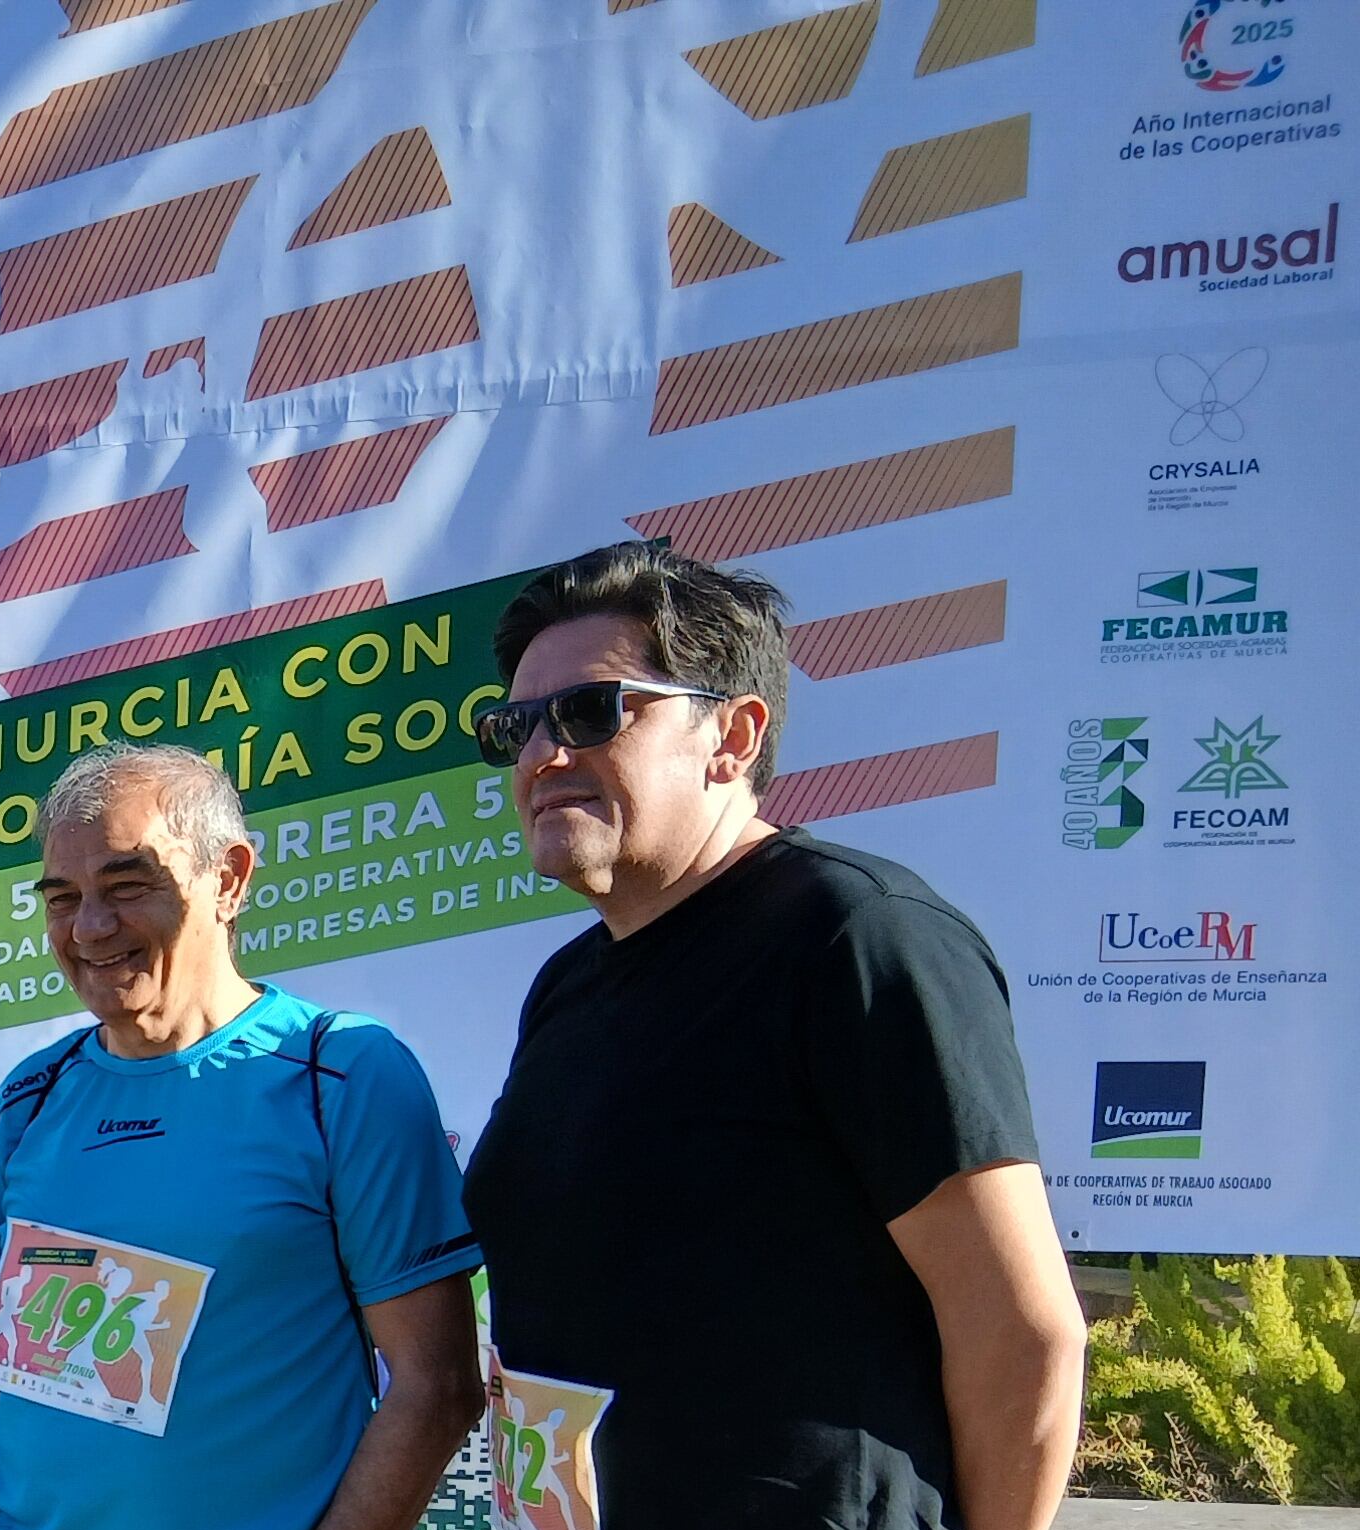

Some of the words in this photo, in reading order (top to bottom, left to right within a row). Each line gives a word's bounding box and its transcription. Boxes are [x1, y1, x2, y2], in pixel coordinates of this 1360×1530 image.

[1231, 19, 1295, 45] 2025
[1133, 116, 1176, 135] Año
[1183, 94, 1332, 130] Internacional
[1120, 142, 1145, 160] de
[1152, 140, 1183, 158] las
[1191, 121, 1342, 154] Cooperativas
[1117, 202, 1340, 284] amusal
[1199, 272, 1269, 293] Sociedad
[1273, 268, 1334, 285] Laboral
[1148, 457, 1261, 481] CRYSALIA
[1102, 610, 1288, 642] FECAMUR
[282, 613, 452, 699] CON
[1059, 718, 1103, 806] AÑOS
[1173, 807, 1290, 830] FECOAM
[240, 896, 416, 955] MPRESAS
[431, 883, 480, 916] DE
[1027, 972, 1073, 987] Unión
[1077, 974, 1098, 986] de
[1102, 971, 1206, 988] Cooperativas
[1211, 971, 1231, 984] de
[1237, 969, 1327, 984] Enseñanza
[1083, 990, 1104, 1004] de
[1108, 990, 1122, 1003] la
[1127, 988, 1183, 1006] Región
[1188, 989, 1208, 1002] de
[1212, 988, 1267, 1002] Murcia
[97, 1117, 162, 1135] Ucomur
[1104, 1105, 1192, 1126] Ucomur
[1056, 1175, 1070, 1188] DE
[1074, 1175, 1147, 1189] COOPERATIVAS
[1151, 1176, 1166, 1189] DE
[1169, 1175, 1215, 1190] TRABAJO
[1218, 1177, 1272, 1190] ASOCIADO
[1092, 1191, 1131, 1206] REGIÓN
[1135, 1194, 1149, 1207] DE
[1152, 1194, 1193, 1208] MURCIA
[19, 1273, 146, 1366] 496
